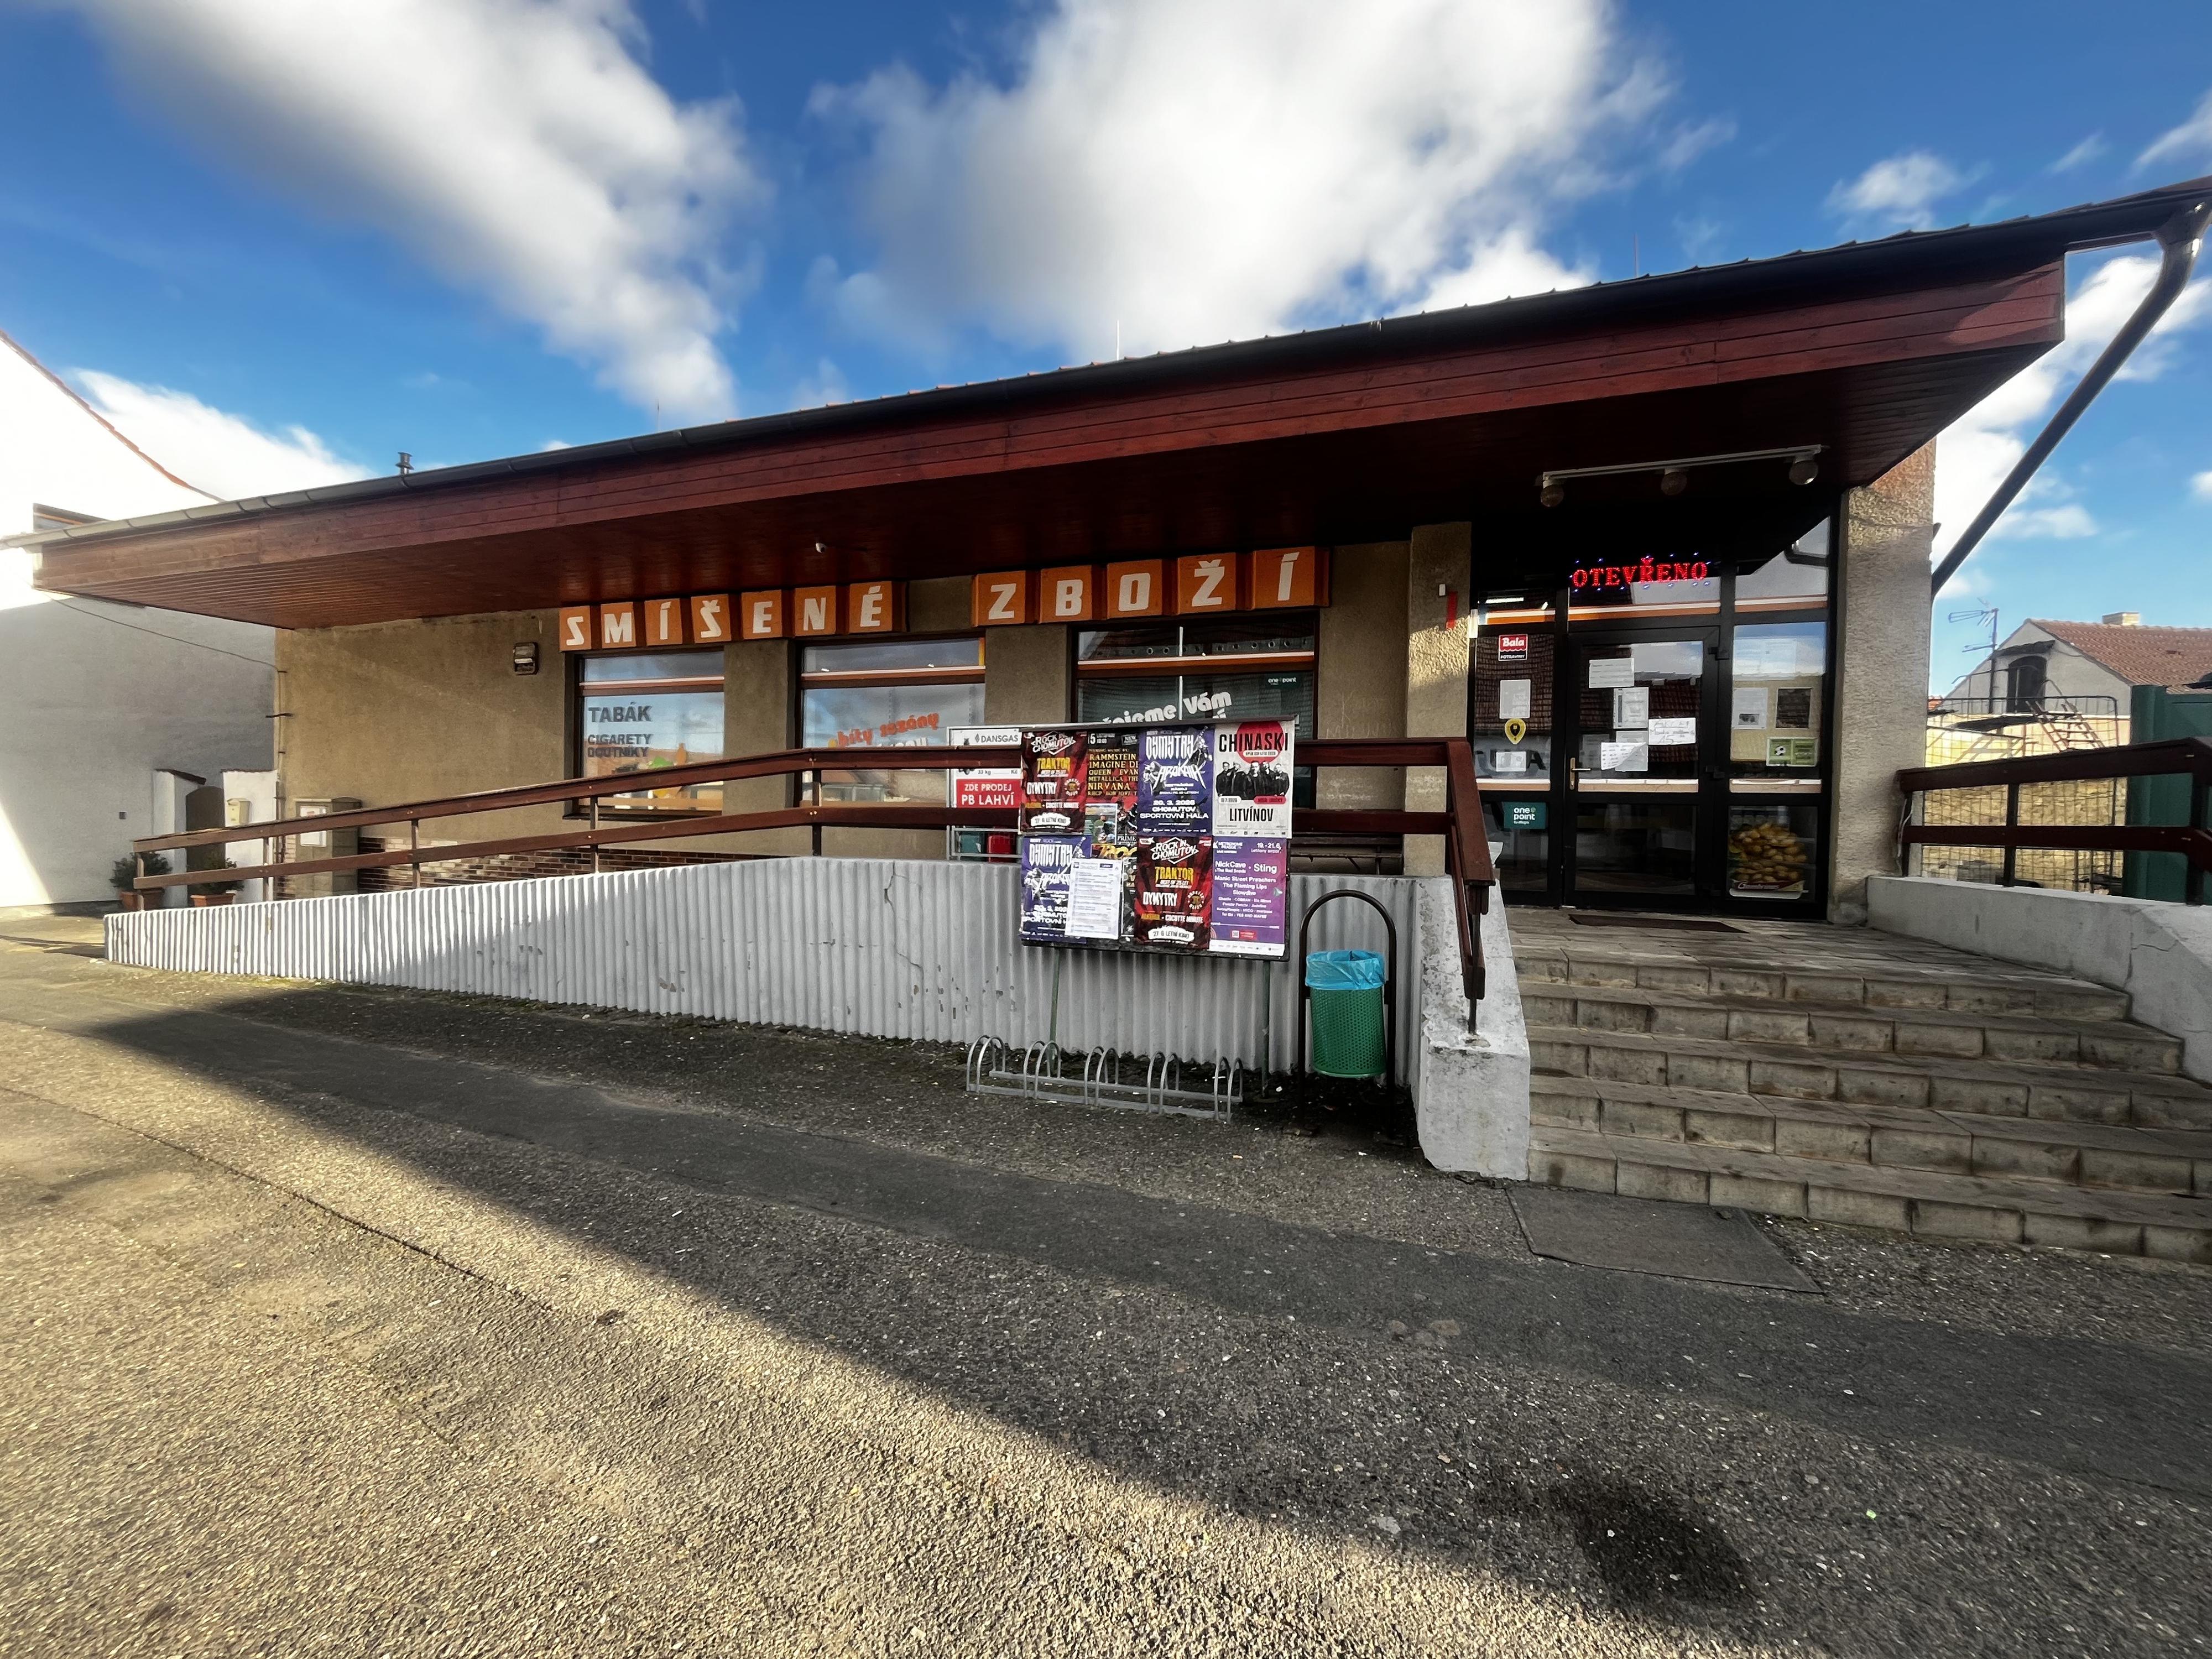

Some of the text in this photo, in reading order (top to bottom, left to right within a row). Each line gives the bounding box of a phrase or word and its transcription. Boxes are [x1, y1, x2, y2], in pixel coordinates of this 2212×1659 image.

[1573, 557, 1708, 587] OTEVŘENO
[566, 552, 1300, 646] SMÍŠENÉ ZBOŽÍ
[1503, 637, 1525, 647] Bala
[1183, 692, 1232, 714] Vám
[588, 702, 653, 723] TABÁK
[587, 734, 653, 745] CIGARETY
[981, 735, 1019, 743] DANSGAS
[1035, 734, 1058, 746] ROCK
[1219, 732, 1288, 752] CHINASKI
[587, 747, 649, 758] DOUTNÍKY
[1146, 734, 1194, 760] DYMYTRY
[964, 783, 1012, 792] ZDE PRODEJ
[1027, 782, 1057, 795] DYMYTRY
[962, 794, 975, 805] PB
[979, 792, 1014, 806] LAHVÍ
[1229, 806, 1274, 822] LITVÍNOV
[1151, 845, 1197, 860] CHOMUTOV
[1155, 841, 1178, 853] ROCK
[1155, 866, 1194, 884] TRAKTOR
[1254, 863, 1277, 874] Sting
[1142, 891, 1177, 906] DYMYTRY
